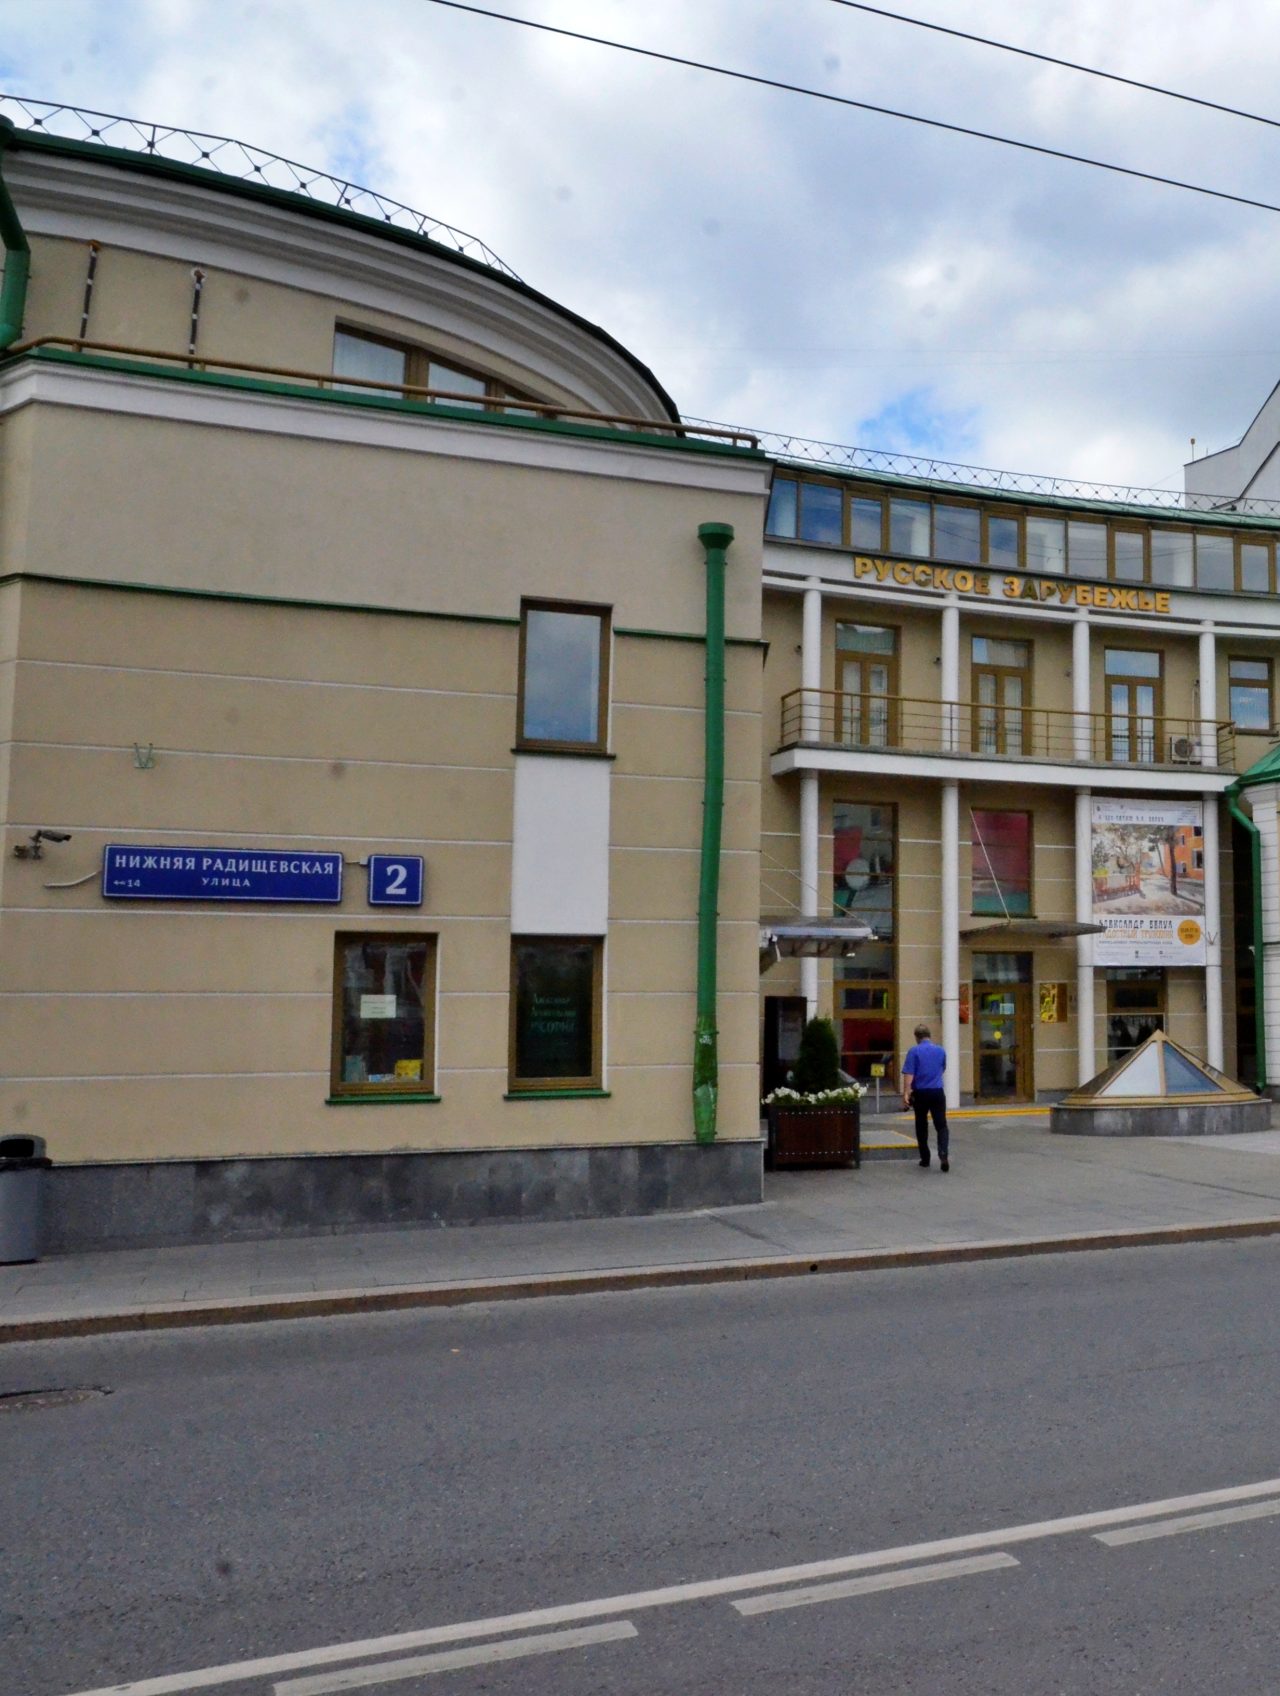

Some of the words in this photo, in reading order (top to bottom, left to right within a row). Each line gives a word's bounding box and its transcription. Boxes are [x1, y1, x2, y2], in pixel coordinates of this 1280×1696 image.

[853, 556, 990, 595] РУССКОЕ
[1003, 576, 1171, 613] ЗАРУБЕЖЬЕ
[115, 855, 195, 871] НИЖНЯЯ
[202, 857, 334, 875] РАДИЩЕВСКАЯ
[127, 879, 141, 888] 14
[202, 877, 251, 888] УЛИЦА
[385, 864, 408, 896] 2
